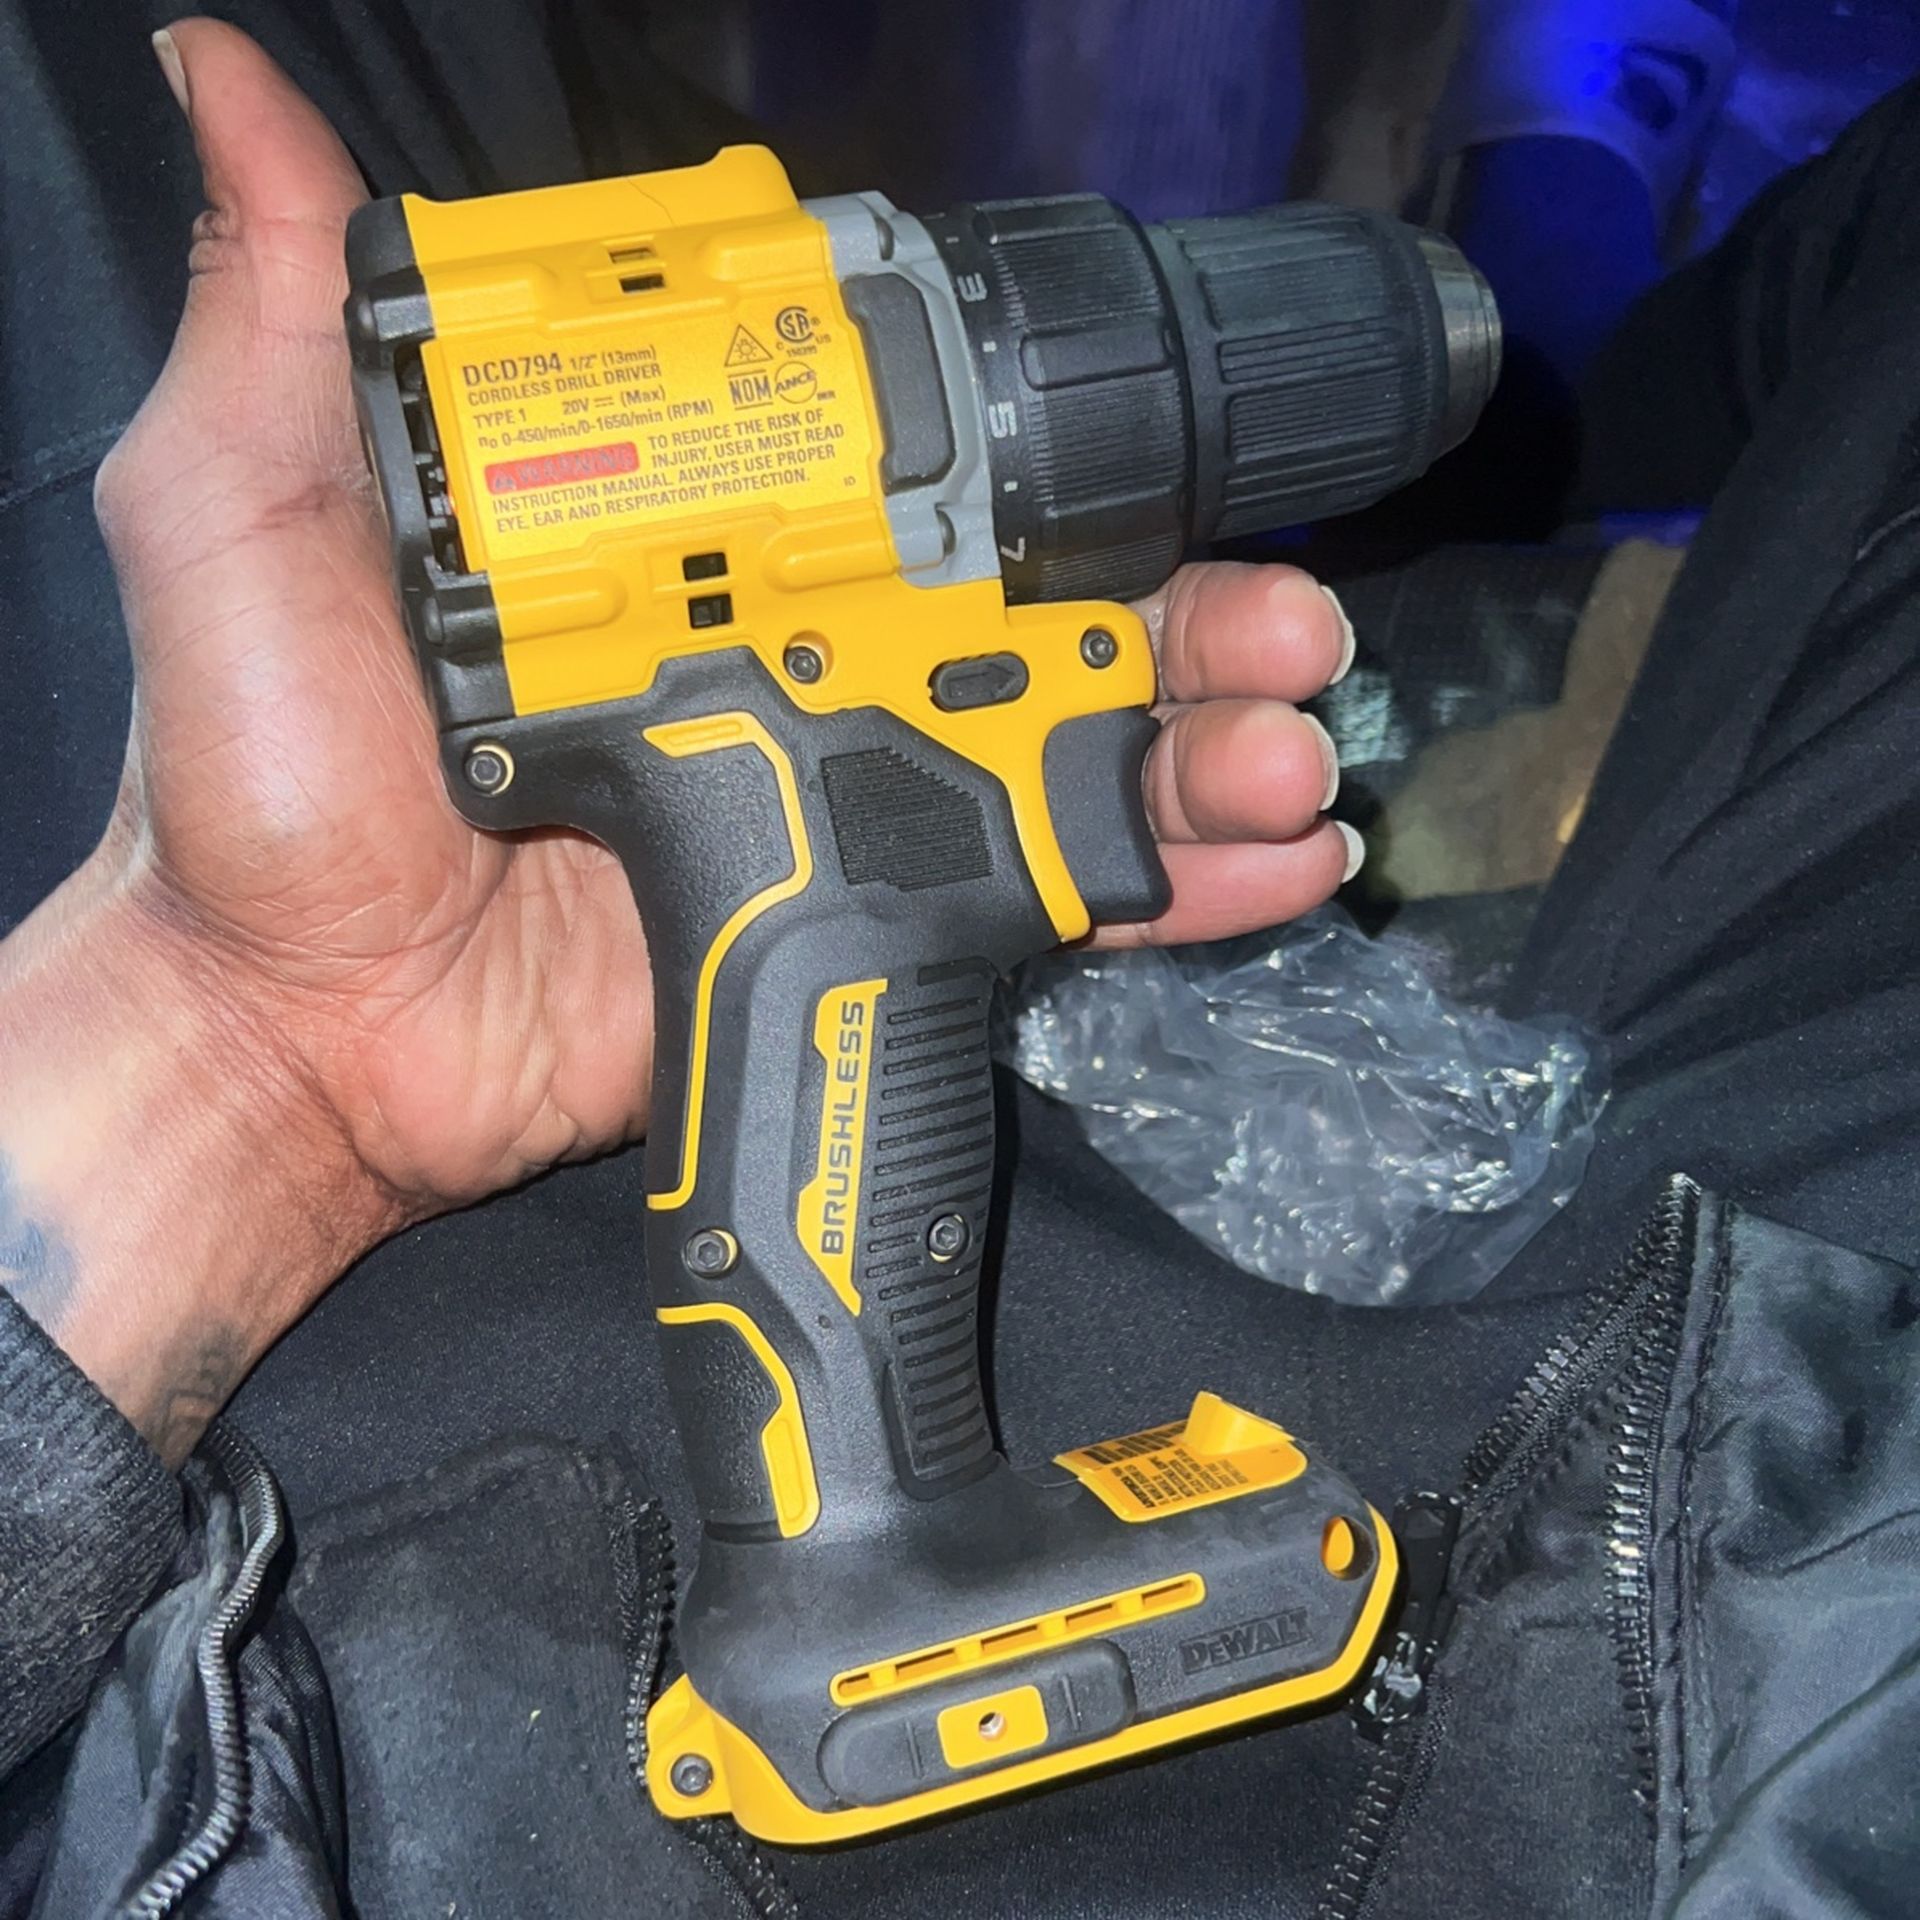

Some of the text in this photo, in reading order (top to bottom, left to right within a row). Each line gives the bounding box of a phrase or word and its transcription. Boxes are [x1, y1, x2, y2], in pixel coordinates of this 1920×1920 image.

[957, 273, 988, 302] 3
[463, 352, 563, 387] DCD794
[602, 344, 657, 367] (13mm)
[468, 363, 662, 406] CORDLESS DRILL DRIVER
[474, 385, 666, 429] TYPE 1 20V (Max)
[729, 376, 773, 405] NOM
[502, 408, 664, 447] 0-450/min/0-1650/min
[668, 399, 714, 422] (RPM)
[648, 408, 824, 451] TO REDUCE THE RISK OF
[988, 401, 1017, 438] 5
[652, 423, 845, 470] INJURY, USER MUST READ
[493, 484, 598, 515] INSTRUCTION
[678, 459, 740, 484] ALWAYS
[744, 454, 773, 472] USE
[778, 444, 836, 467] PROPER
[534, 509, 564, 528] EAR
[568, 503, 601, 522] AND
[606, 485, 708, 518] RESPIRATORY
[713, 468, 810, 497] PROTECTION.
[1000, 537, 1026, 562] 7
[821, 1000, 865, 1256] BRUSHLESS
